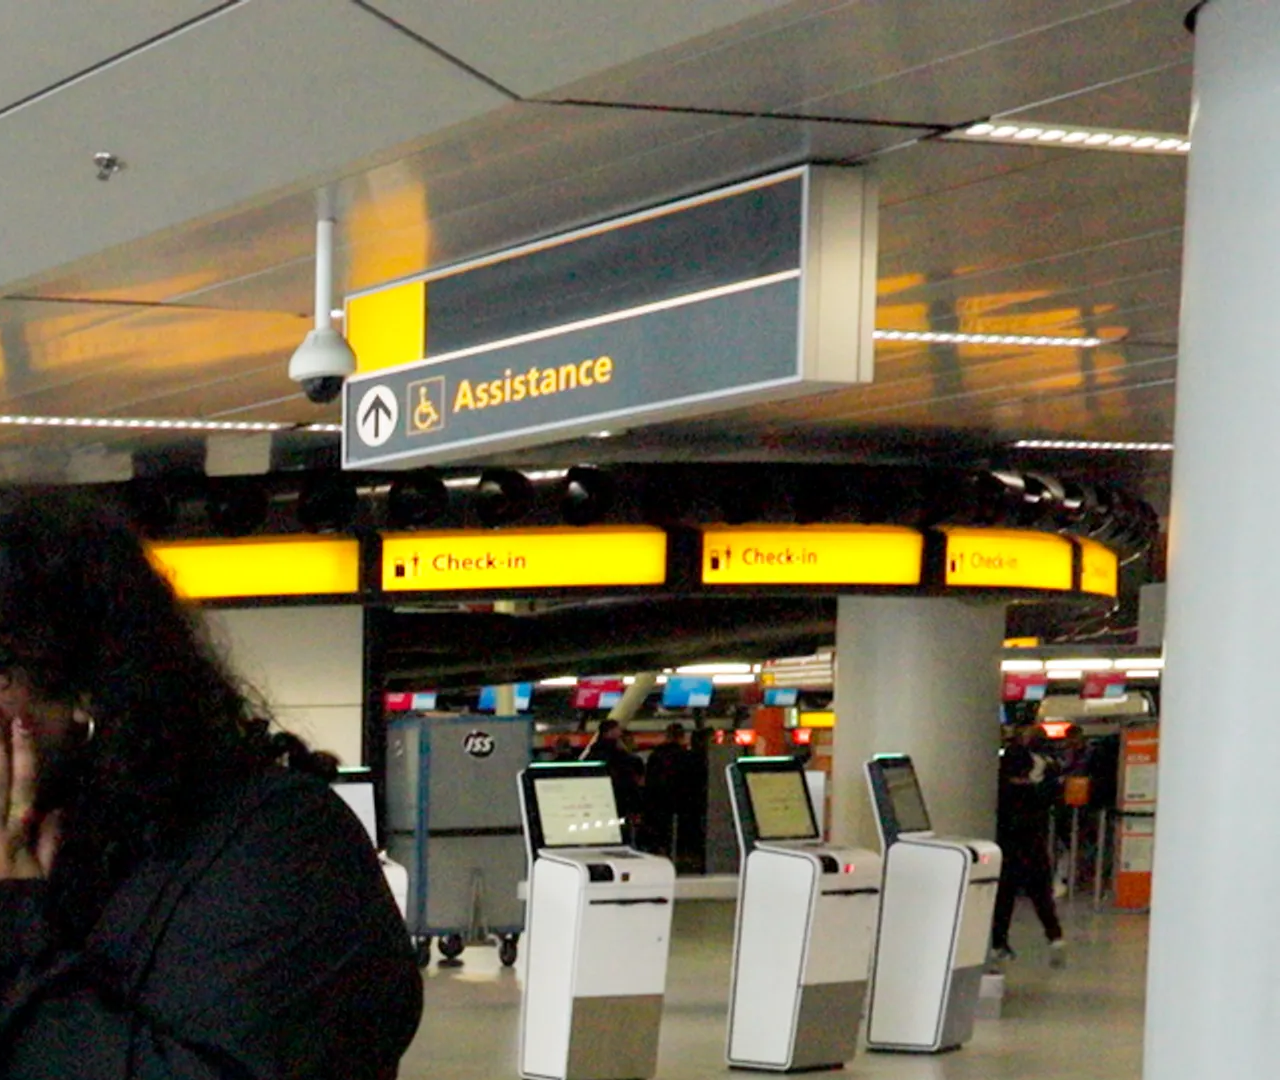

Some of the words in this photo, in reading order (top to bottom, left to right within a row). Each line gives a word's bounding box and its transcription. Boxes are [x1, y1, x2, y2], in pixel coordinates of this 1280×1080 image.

[453, 355, 613, 413] Assistance
[432, 552, 526, 571] Check-in
[742, 548, 818, 565] Check-in
